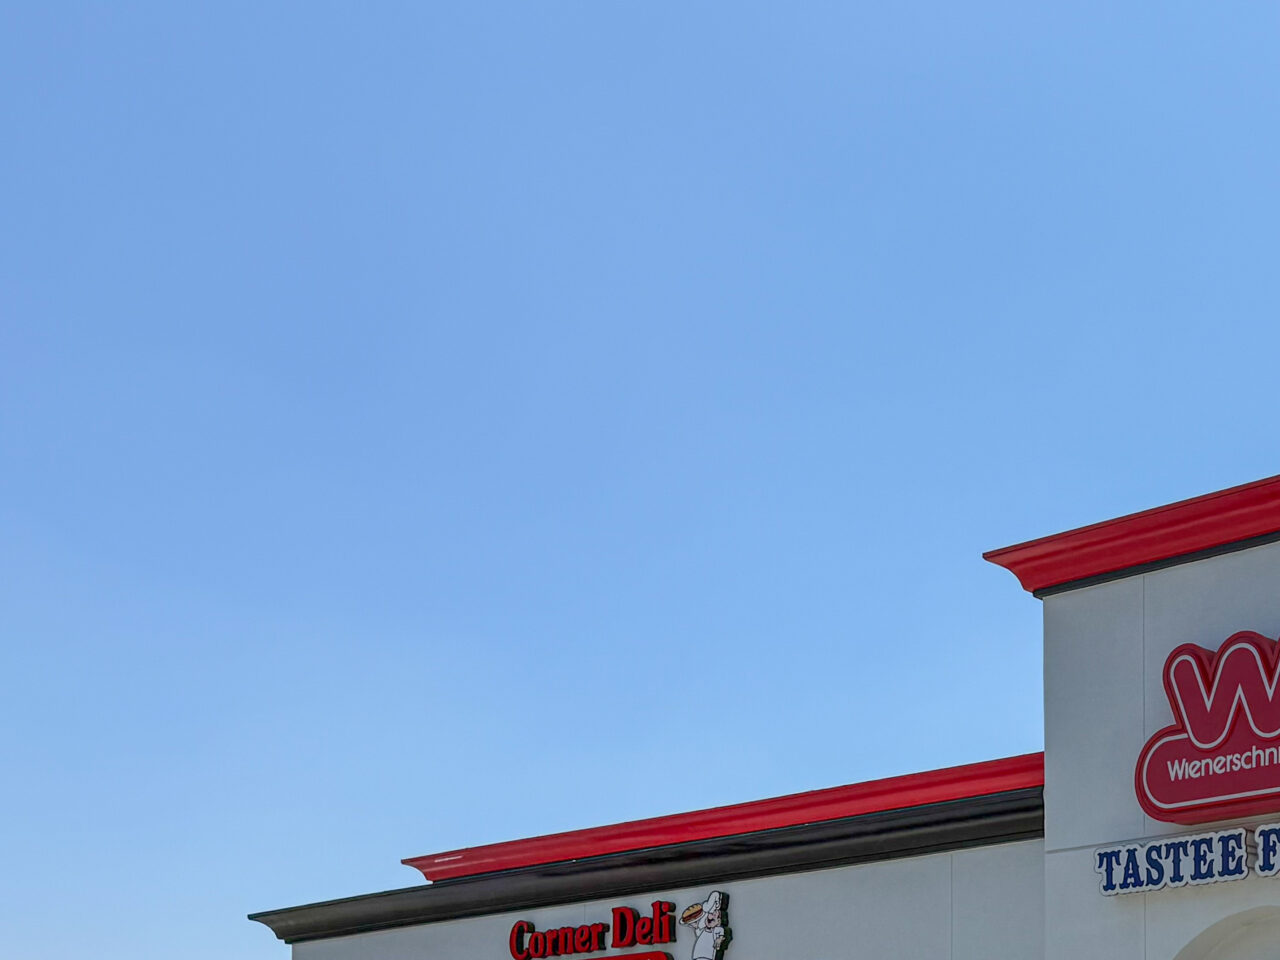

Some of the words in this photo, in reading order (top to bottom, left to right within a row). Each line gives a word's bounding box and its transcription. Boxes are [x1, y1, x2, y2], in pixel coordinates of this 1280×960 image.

[1097, 828, 1247, 892] TASTEE
[509, 920, 606, 960] Corner
[611, 901, 673, 948] Deli
